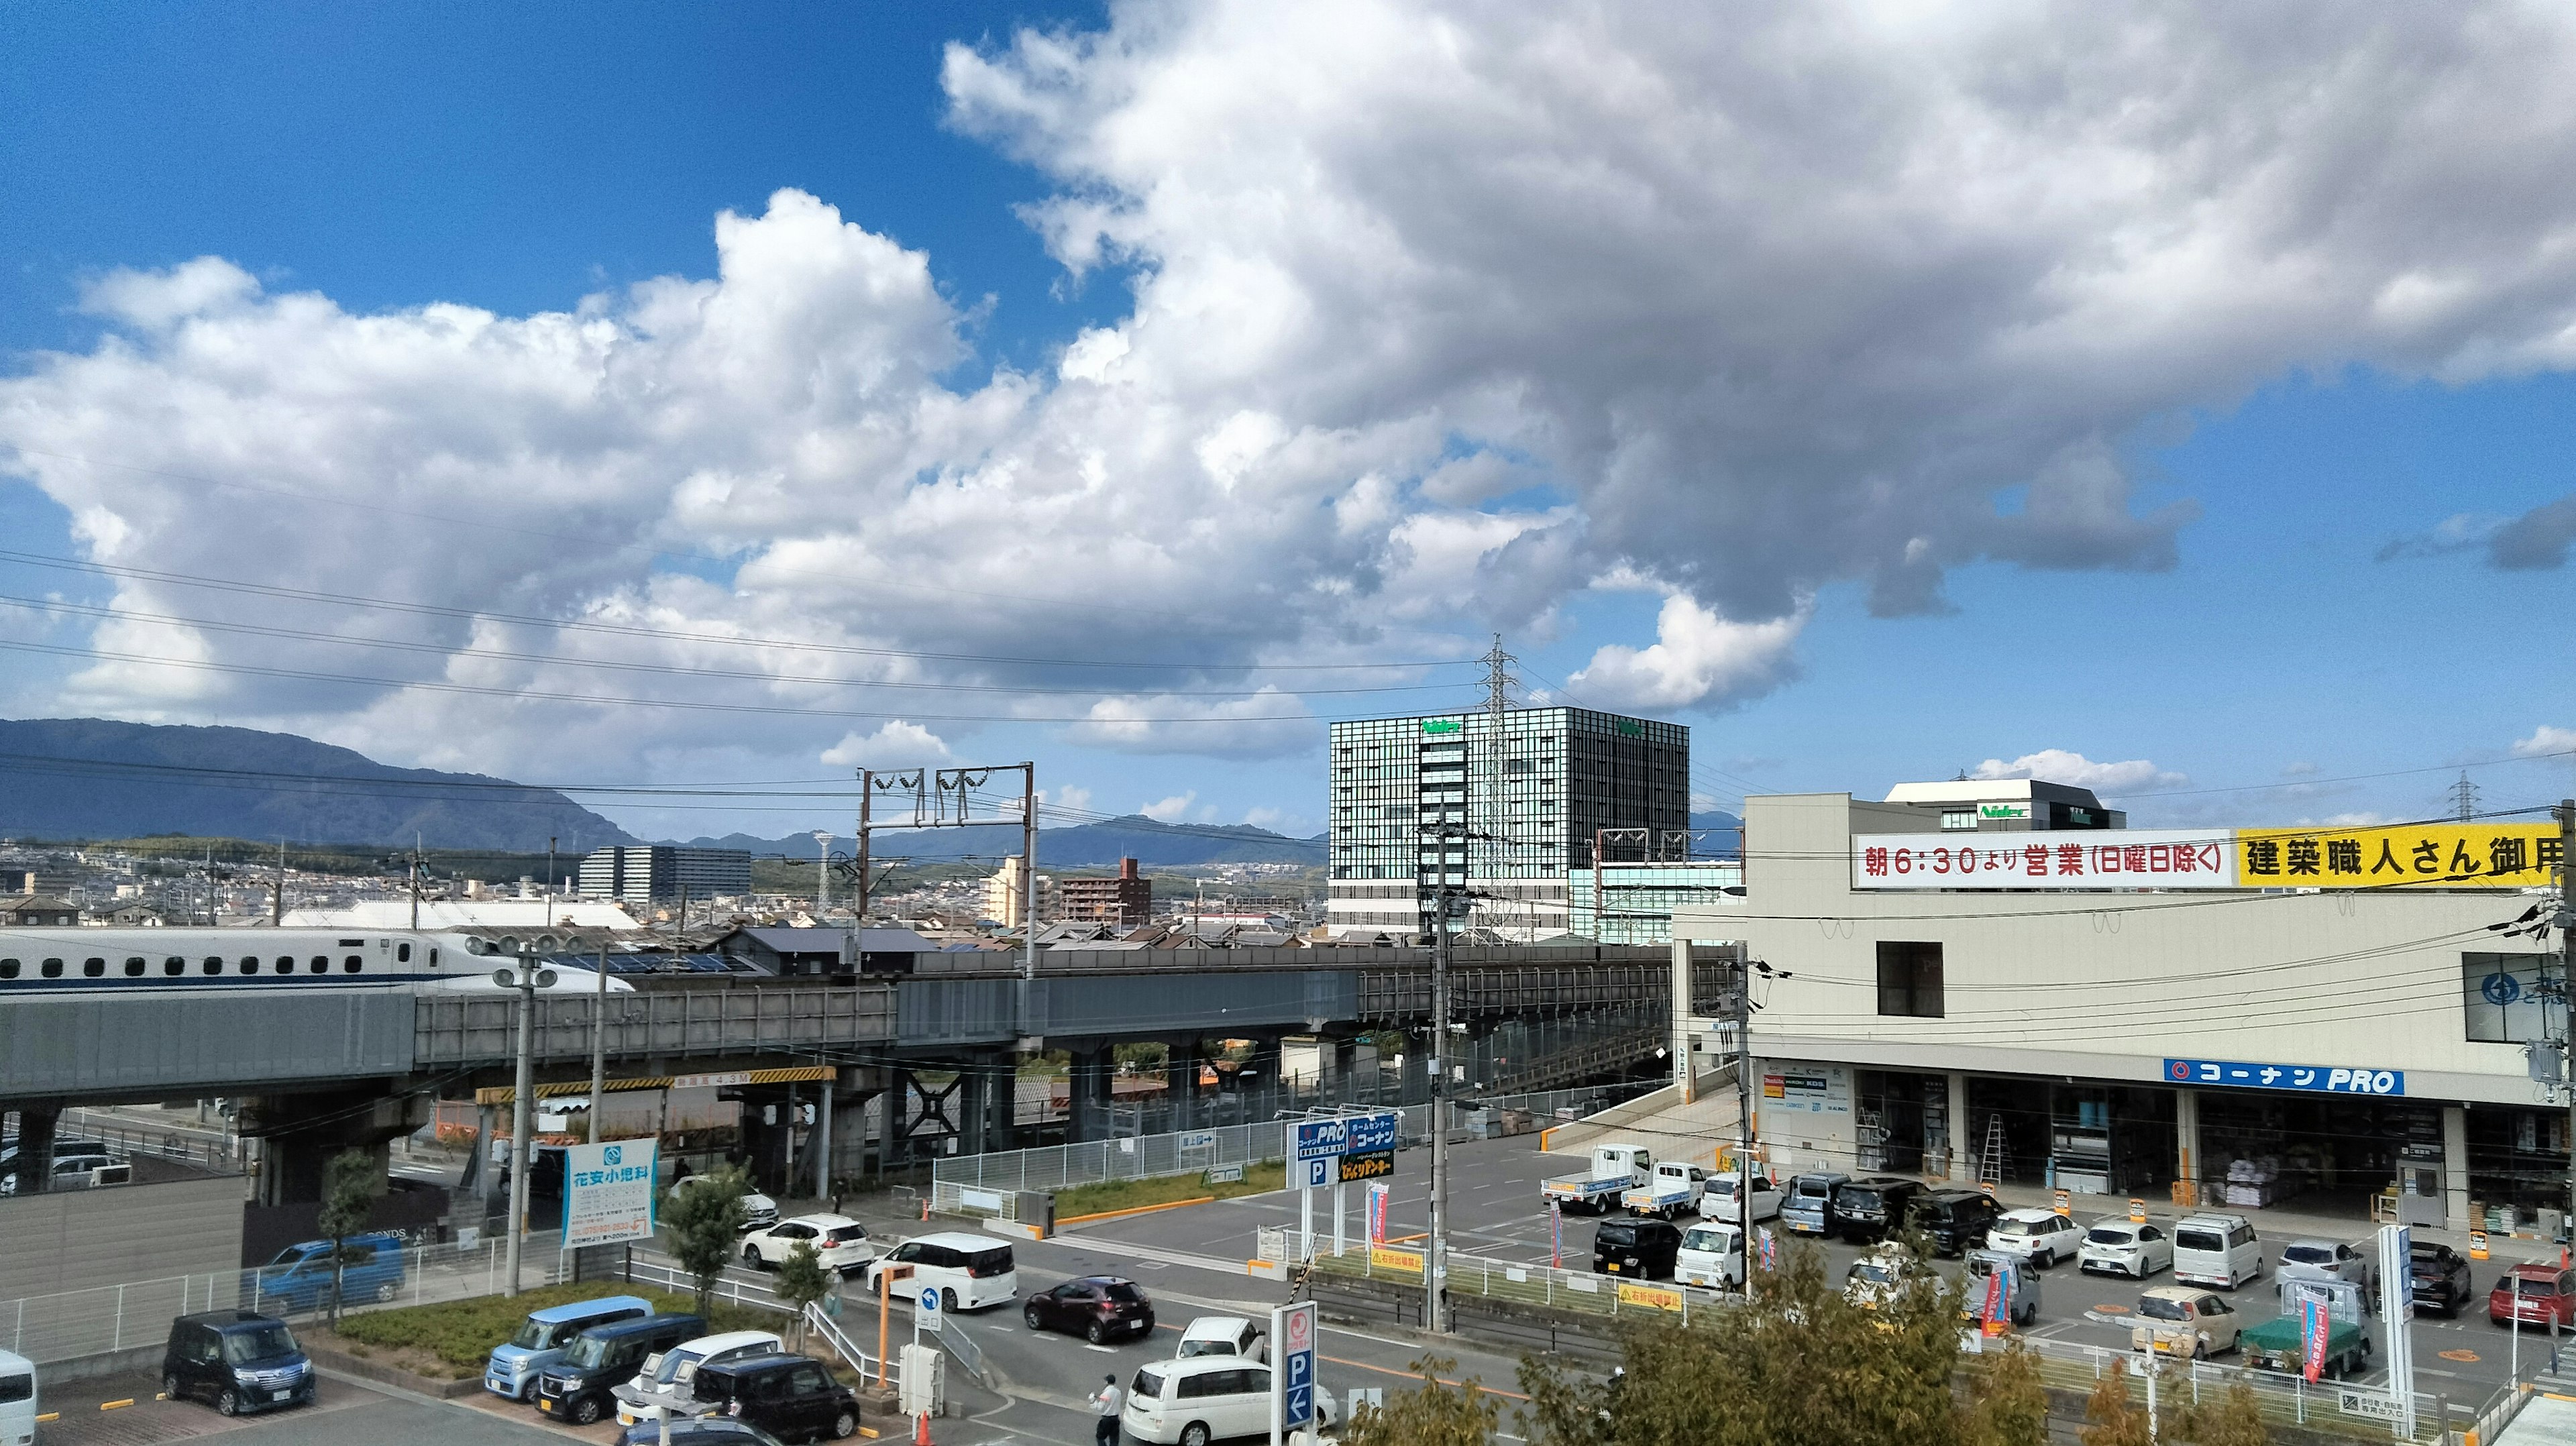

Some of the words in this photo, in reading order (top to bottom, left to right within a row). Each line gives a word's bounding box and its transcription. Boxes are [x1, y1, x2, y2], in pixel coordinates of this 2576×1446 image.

[2200, 1064, 2315, 1086] コーナン
[2327, 1069, 2395, 1093] PRO
[1316, 1124, 1346, 1144] PRO
[1352, 1121, 1391, 1132] ホームセンター
[1357, 1130, 1393, 1148] コーナン
[1312, 1162, 1324, 1183] P
[1291, 1355, 1306, 1386] P
